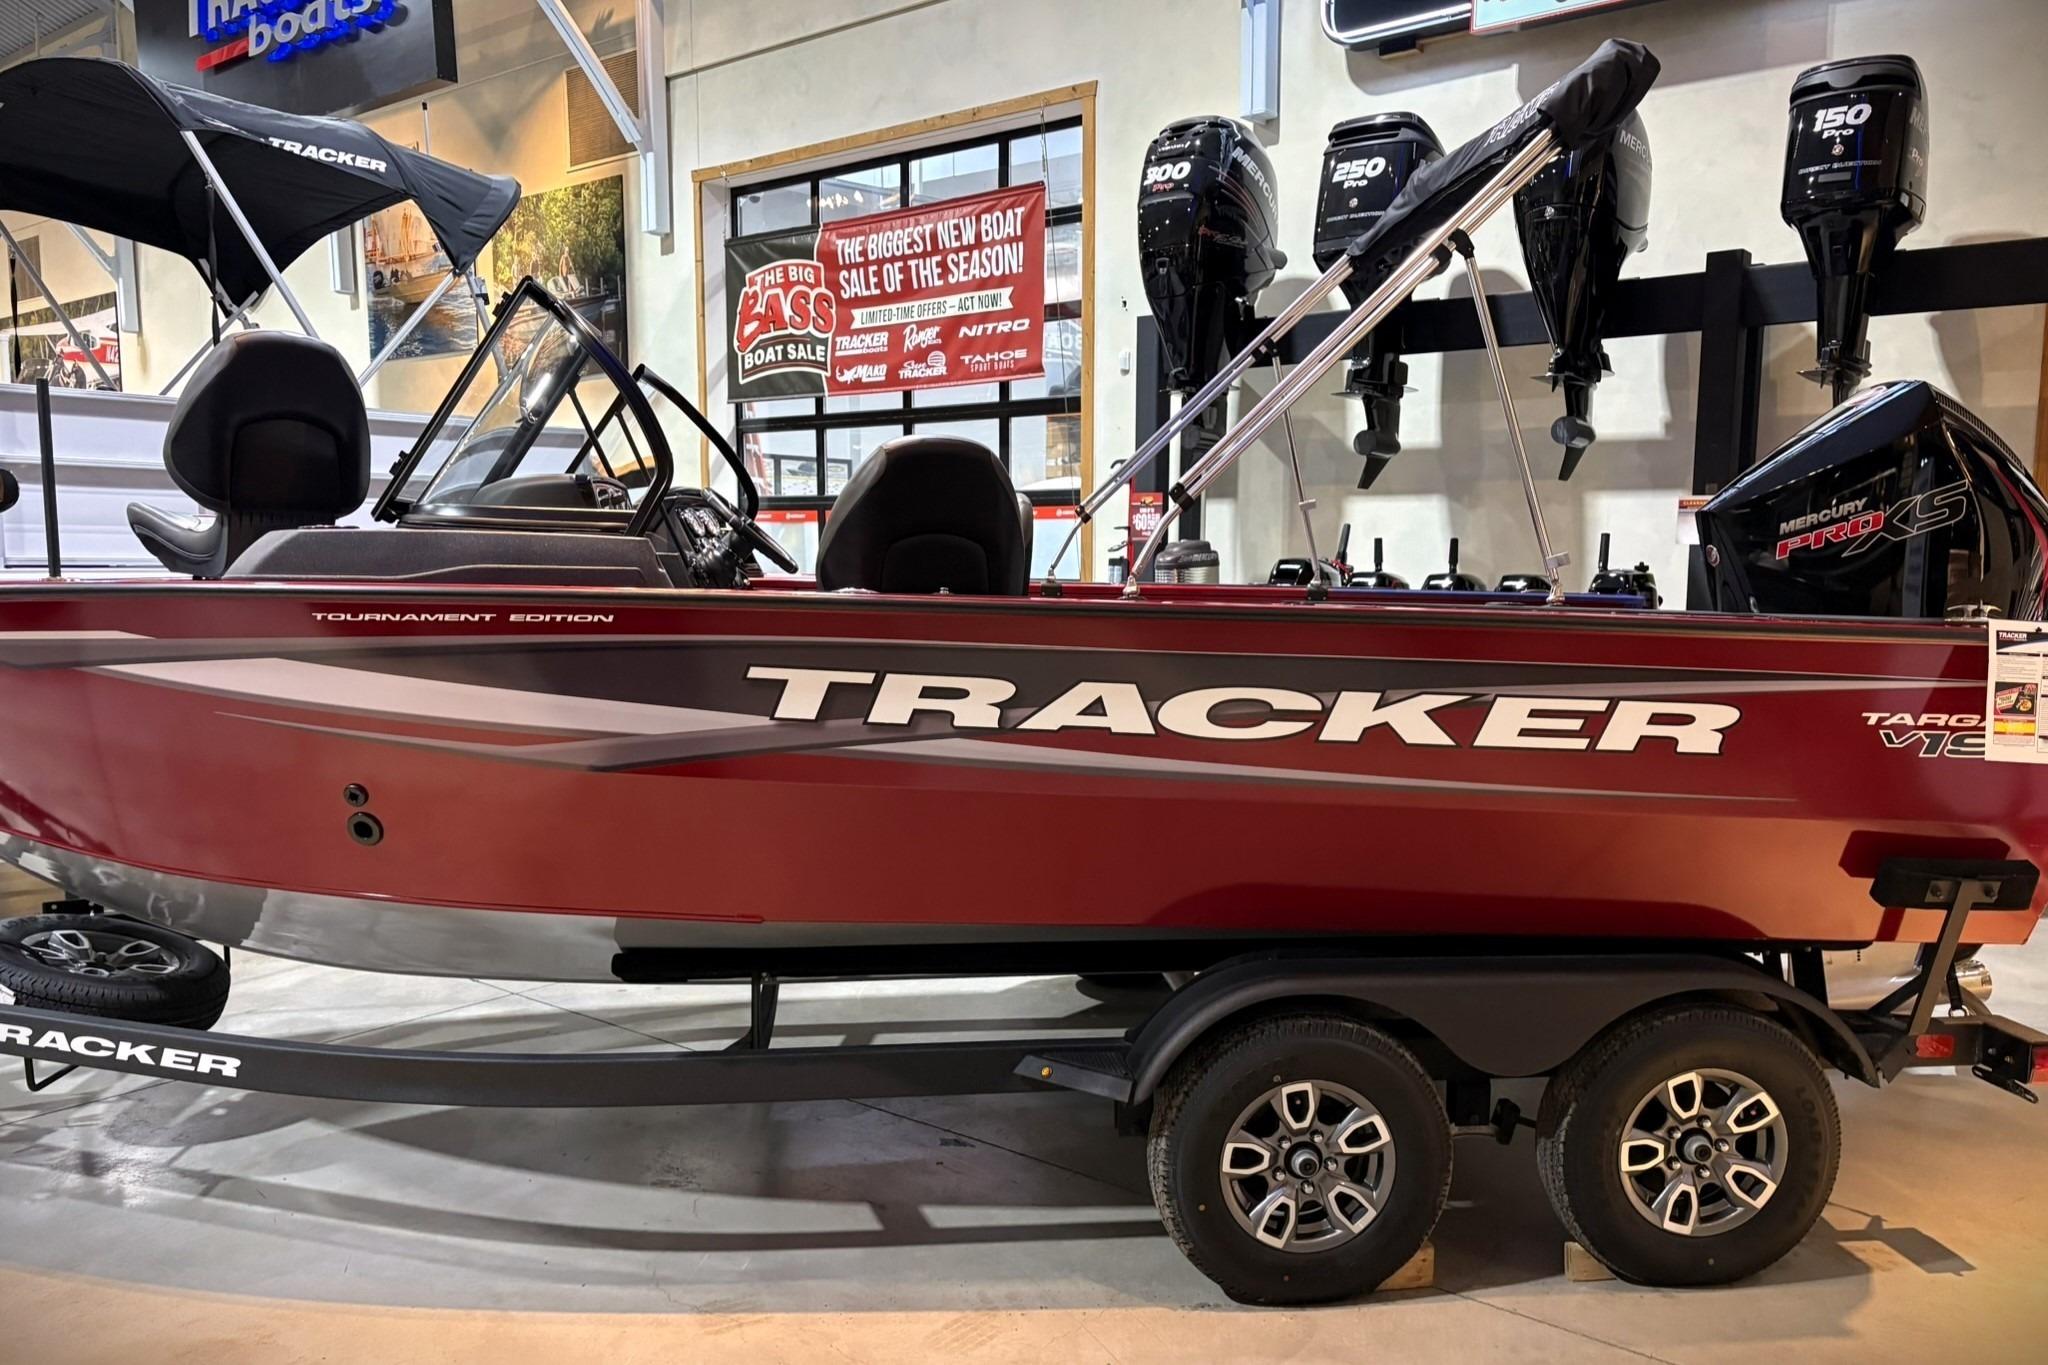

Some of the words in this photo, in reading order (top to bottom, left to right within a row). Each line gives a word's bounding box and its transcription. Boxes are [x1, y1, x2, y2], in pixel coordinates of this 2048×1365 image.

[1813, 103, 1872, 132] 150
[268, 136, 387, 173] TRACKER
[1332, 157, 1386, 183] 250
[835, 236, 866, 266] THE
[867, 224, 934, 261] BIGGEST
[937, 215, 976, 250] NEW
[980, 206, 1025, 243] BOAT
[754, 266, 786, 289] THE
[787, 265, 816, 284] BIG
[839, 265, 881, 299] SALE
[882, 261, 904, 293] OF
[907, 255, 944, 290] THE
[946, 241, 1024, 284] SEASON!
[736, 287, 834, 353] BASS
[860, 305, 915, 326] LIMITED-TIME
[917, 300, 947, 318] OFFERS
[957, 296, 975, 312] ACT
[977, 292, 1002, 309] NOW!
[834, 331, 889, 350] TRACKER
[958, 318, 1031, 338] NITRO
[744, 345, 784, 369] BOAT
[786, 343, 826, 362] SALE
[960, 348, 1028, 365] TAHOE
[898, 366, 948, 379] TRACKER
[1779, 497, 1868, 535] MERCURY
[312, 612, 497, 622] TOURNAMENT
[509, 613, 615, 623] EDITION
[1998, 632, 2028, 640] TRACKER
[745, 665, 1742, 755] TRACKER
[1861, 712, 1986, 727] TARG
